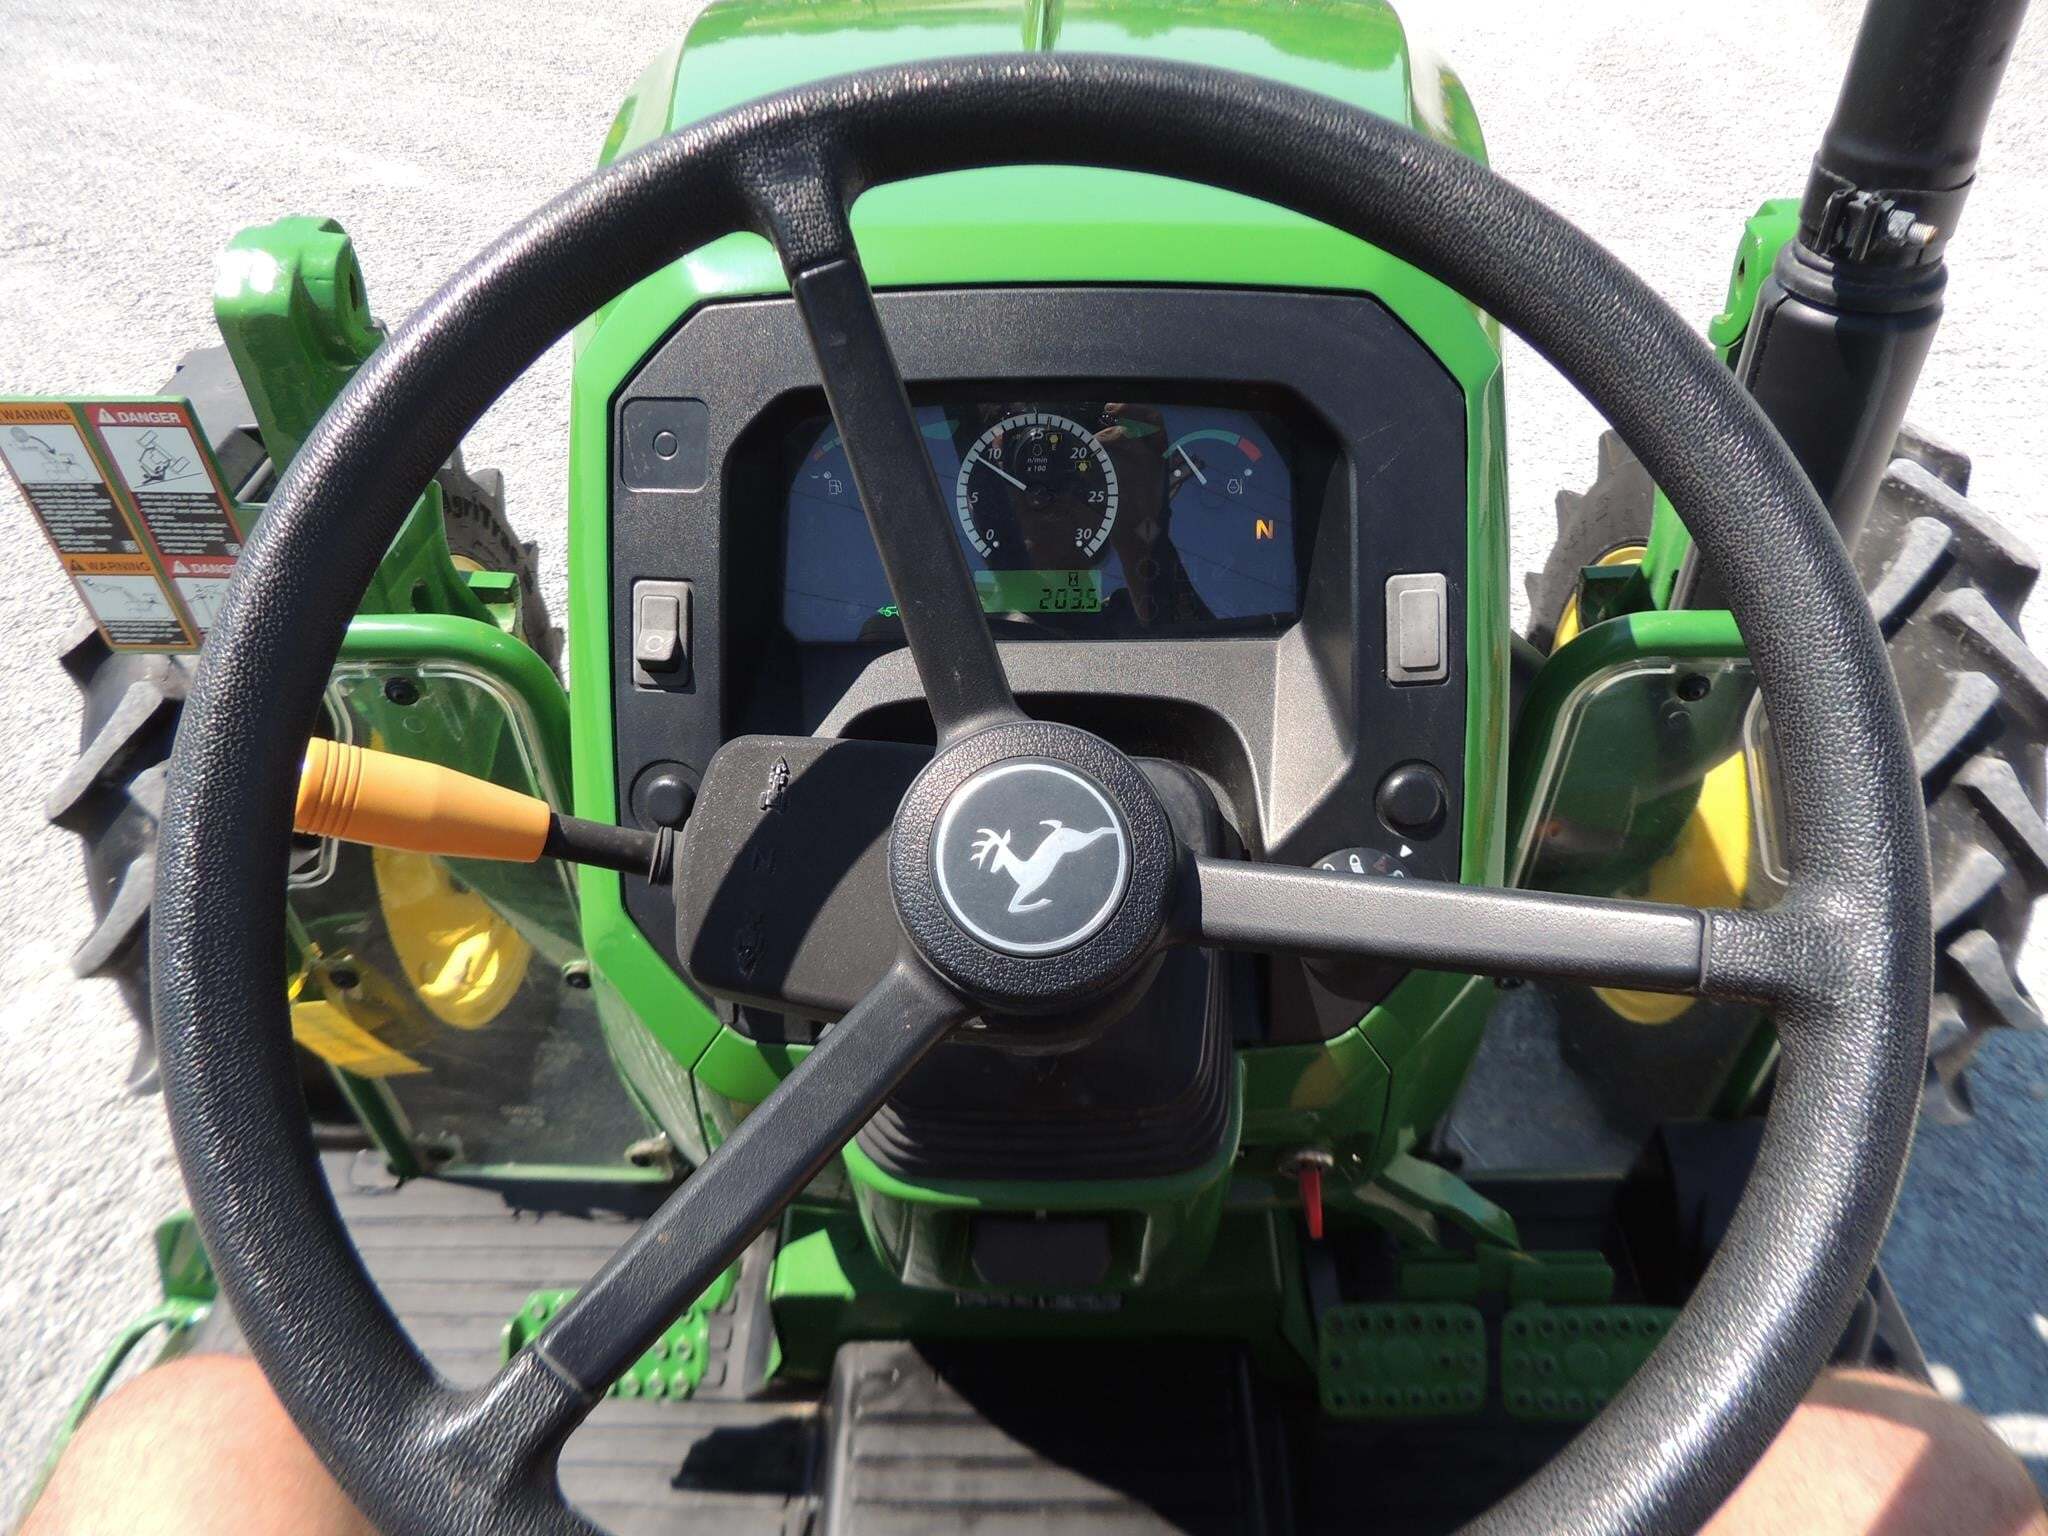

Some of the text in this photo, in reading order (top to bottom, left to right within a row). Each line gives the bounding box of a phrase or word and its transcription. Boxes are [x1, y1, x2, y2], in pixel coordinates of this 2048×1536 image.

[3, 408, 71, 420] WARNING
[117, 411, 181, 424] DANGER
[987, 448, 1002, 460] 10
[1069, 447, 1087, 459] 20
[1027, 456, 1048, 464] n/min
[969, 491, 979, 503] 5
[1087, 490, 1105, 503] 25
[985, 528, 995, 540] 0
[1075, 528, 1092, 540] 30
[1256, 519, 1274, 540] N
[87, 561, 151, 571] WARNING
[190, 564, 236, 575] DANGE
